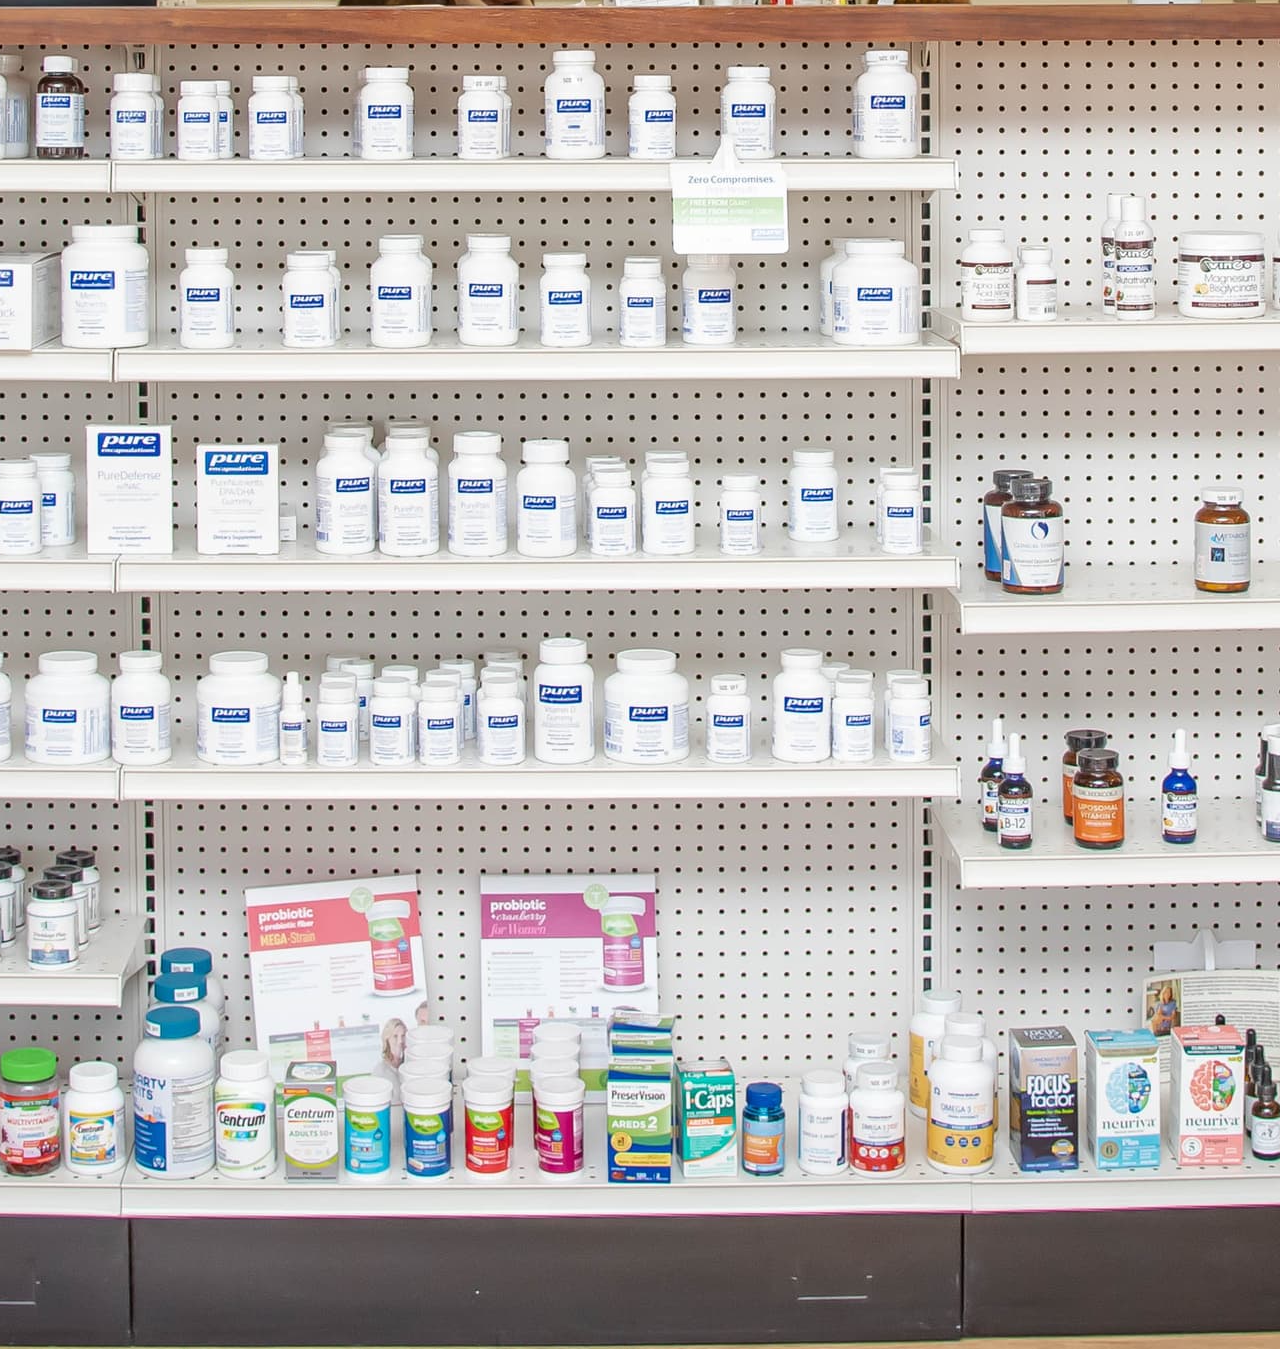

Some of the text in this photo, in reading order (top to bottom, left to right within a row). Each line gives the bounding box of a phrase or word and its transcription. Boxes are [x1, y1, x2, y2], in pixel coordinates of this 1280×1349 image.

[873, 97, 904, 105] pure
[734, 105, 764, 113] pure
[688, 175, 776, 185] Zero Compromises.
[73, 273, 112, 283] pure
[1204, 273, 1256, 283] Magnesium
[189, 289, 218, 297] pure
[471, 285, 501, 293] pure
[860, 289, 891, 297] pure
[1209, 283, 1258, 295] Bisglycinate
[293, 296, 322, 304] pure
[701, 291, 729, 299] pure
[104, 436, 156, 447] pure
[211, 455, 264, 466] pure
[97, 470, 161, 481] PureDefense
[338, 479, 368, 487] pure
[460, 480, 491, 488] pure
[804, 489, 832, 497] pure
[526, 497, 555, 505] pure
[658, 502, 687, 510] pure
[541, 687, 580, 698] pure
[786, 698, 821, 708] pure
[123, 707, 153, 715] pure
[214, 709, 248, 718] pure
[631, 708, 666, 717] pure
[1077, 803, 1118, 812] LIPOSOMAL
[1080, 811, 1117, 819] VITAMIN C
[1004, 817, 1026, 829] B-12
[490, 899, 546, 912] probiotic
[258, 907, 314, 924] probiotic
[297, 920, 314, 929] fiber
[489, 924, 547, 937] for Women
[1027, 1075, 1070, 1094] FOCUS
[611, 1090, 665, 1102] PreserVision
[1030, 1092, 1074, 1107] factor
[219, 1111, 266, 1127] Centrum
[287, 1108, 335, 1120] Centrum
[611, 1116, 658, 1129] AREDS 2
[1102, 1115, 1157, 1130] neuriva
[1185, 1113, 1239, 1127] neuriva
[1122, 1138, 1140, 1146] Plus
[1188, 1143, 1196, 1152] 5
